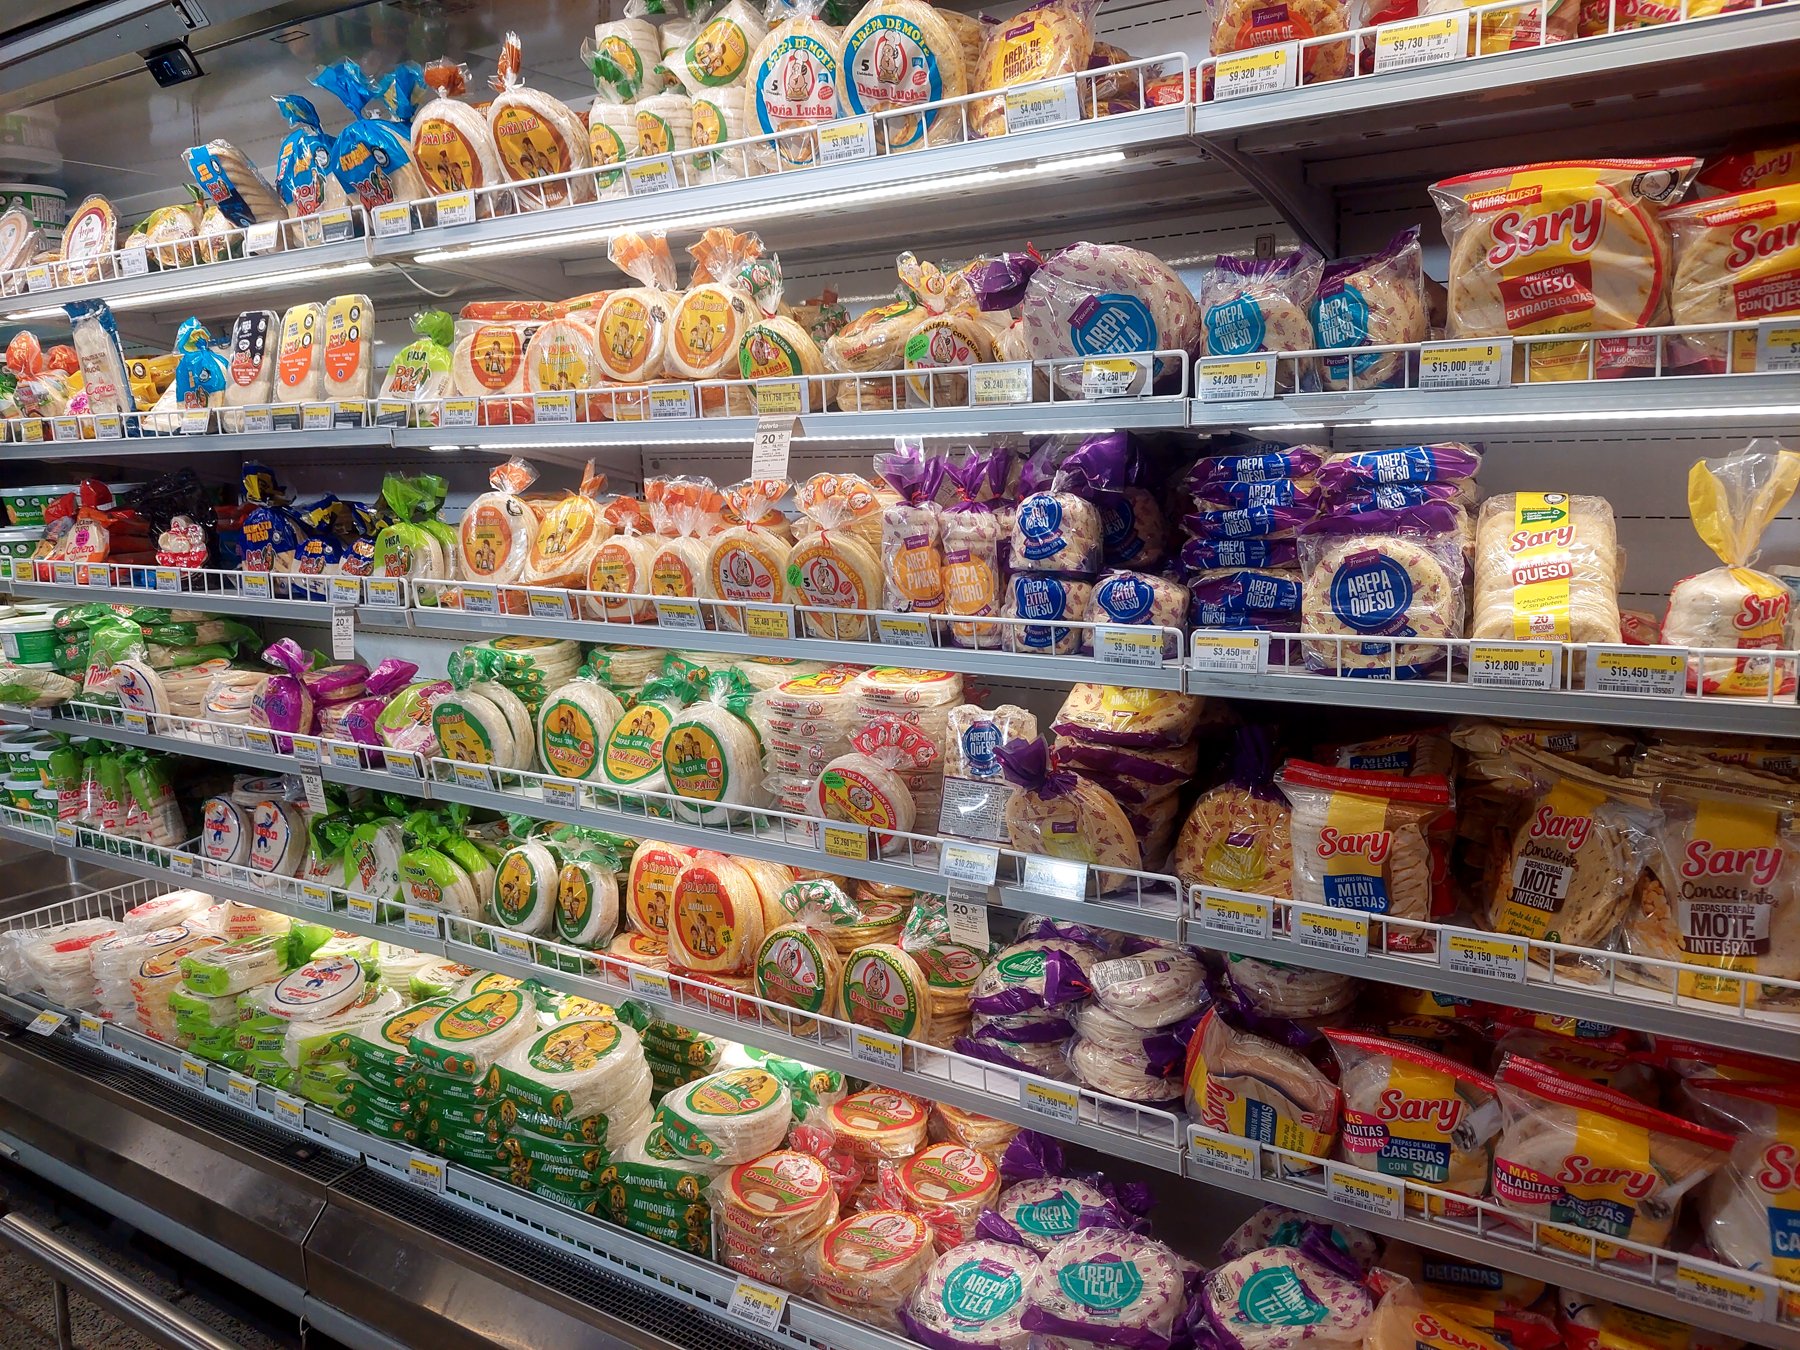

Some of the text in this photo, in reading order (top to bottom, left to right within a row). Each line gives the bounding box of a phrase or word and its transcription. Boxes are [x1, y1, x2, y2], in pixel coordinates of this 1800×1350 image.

[1528, 8, 1536, 19] 4
[1446, 20, 1452, 28] B
[851, 18, 902, 50] AREPA DE
[1250, 26, 1294, 45] AREPA DE
[1393, 37, 1423, 51] $9,730
[794, 39, 836, 71] DE MOTE
[1003, 38, 1041, 67] AREPA DE
[1274, 50, 1280, 60] C
[862, 60, 869, 71] 5
[1229, 68, 1255, 81] $9,320
[771, 80, 778, 90] 5
[859, 83, 927, 101] Doña Lucha
[766, 101, 832, 116] Doña Lucha
[1739, 152, 1793, 183] Sary
[1489, 199, 1603, 265] Sary
[1525, 267, 1565, 283] AREPAS CON
[1520, 273, 1575, 299] QUESO
[1506, 292, 1593, 320] EXTRADELGADAS
[1739, 300, 1762, 312] CON
[1215, 305, 1244, 325] AREPA
[1084, 306, 1131, 348] AREPA
[1215, 324, 1237, 338] RELLENA
[1220, 331, 1252, 351] QUESO
[1487, 346, 1492, 355] B
[1256, 362, 1261, 370] C
[1432, 361, 1466, 372] $15,000
[1213, 375, 1237, 385] $4,280
[762, 435, 775, 444] 20
[1236, 457, 1263, 471] AREPA
[1376, 452, 1408, 469] AREPA
[1378, 464, 1410, 483] QUESO
[1248, 484, 1276, 499] AREPA
[1222, 509, 1248, 522] AREPA
[1225, 519, 1251, 536] QUESO
[1509, 525, 1574, 552] Sary
[1218, 541, 1245, 552] AREPA
[1219, 552, 1246, 566] QUESO
[723, 570, 728, 578] 5
[1515, 563, 1570, 585] QUESO
[803, 578, 810, 587] 5
[1024, 580, 1048, 593] AREPA
[1248, 579, 1278, 596] AREPA
[1347, 569, 1392, 598] AREPA
[1026, 593, 1050, 606] EXTRA
[1246, 592, 1274, 609] QUESO
[1351, 590, 1395, 618] QUESO
[1025, 603, 1053, 619] QUESO
[1202, 610, 1226, 624] QUESO
[1533, 615, 1548, 624] 20
[1530, 623, 1554, 632] PORCIONES
[1114, 642, 1136, 652] $9,150
[1254, 638, 1259, 647] B
[1213, 648, 1240, 657] $3,450
[1539, 650, 1545, 658] C
[1485, 660, 1519, 671] $12,800
[1671, 656, 1676, 665] C
[1611, 667, 1648, 678] $15,450
[969, 732, 996, 742] AREPITAS
[1549, 736, 1574, 746] MOTE
[710, 761, 718, 769] 10
[1362, 755, 1398, 764] MINI
[1762, 760, 1793, 770] MOTE
[1530, 806, 1593, 849] Sary
[1316, 827, 1391, 864] Sary
[1524, 841, 1578, 867] Consciente
[1682, 841, 1783, 883] Sary
[1338, 881, 1374, 897] MINI
[1520, 868, 1559, 896] MOTE
[951, 892, 969, 900] oferta
[1682, 881, 1777, 905] Consciente
[1329, 896, 1388, 910] CASERAS
[1514, 891, 1555, 911] INTEGRAL
[1690, 904, 1732, 912] AREPAS DE
[953, 904, 968, 915] 20
[1217, 908, 1240, 920] $5,870
[1312, 925, 1337, 937] $6,680
[1356, 922, 1360, 930] C
[1690, 913, 1756, 939] MOTE
[1512, 944, 1518, 954] A
[1690, 940, 1758, 955] INTEGRAL
[1464, 950, 1491, 962] $3,150
[764, 970, 813, 996] Doña Lucha
[850, 990, 904, 1019] Doña Lucha
[1202, 1073, 1235, 1133] Sary
[1378, 1090, 1461, 1131] Sary
[668, 1127, 678, 1141] CON
[1391, 1139, 1412, 1147] AREPAS
[530, 1150, 573, 1165] ANTIOQUEÑA
[1206, 1148, 1229, 1159] $1,950
[1381, 1146, 1444, 1163] CASERAS
[916, 1161, 977, 1186] Doña Lucha
[1388, 1162, 1442, 1182] CON SAL
[1557, 1155, 1656, 1197] Sary
[626, 1175, 667, 1190] ANTIOQUEÑA
[745, 1170, 808, 1197] Doña Lucha
[1496, 1167, 1560, 1194] SALADITAS
[1345, 1184, 1369, 1198] $6,580
[1501, 1184, 1558, 1200] GRUESITAS
[634, 1198, 675, 1217] ANTIOQUEÑA
[1032, 1204, 1072, 1222] AREPA
[1556, 1199, 1625, 1223] CASERAS
[1040, 1219, 1071, 1229] TELA
[1426, 1264, 1500, 1285] DELGADAS
[964, 1273, 1006, 1301] AREPA
[1083, 1277, 1120, 1298] TELA
[958, 1293, 991, 1315] TELA
[1255, 1293, 1288, 1324] TELA
